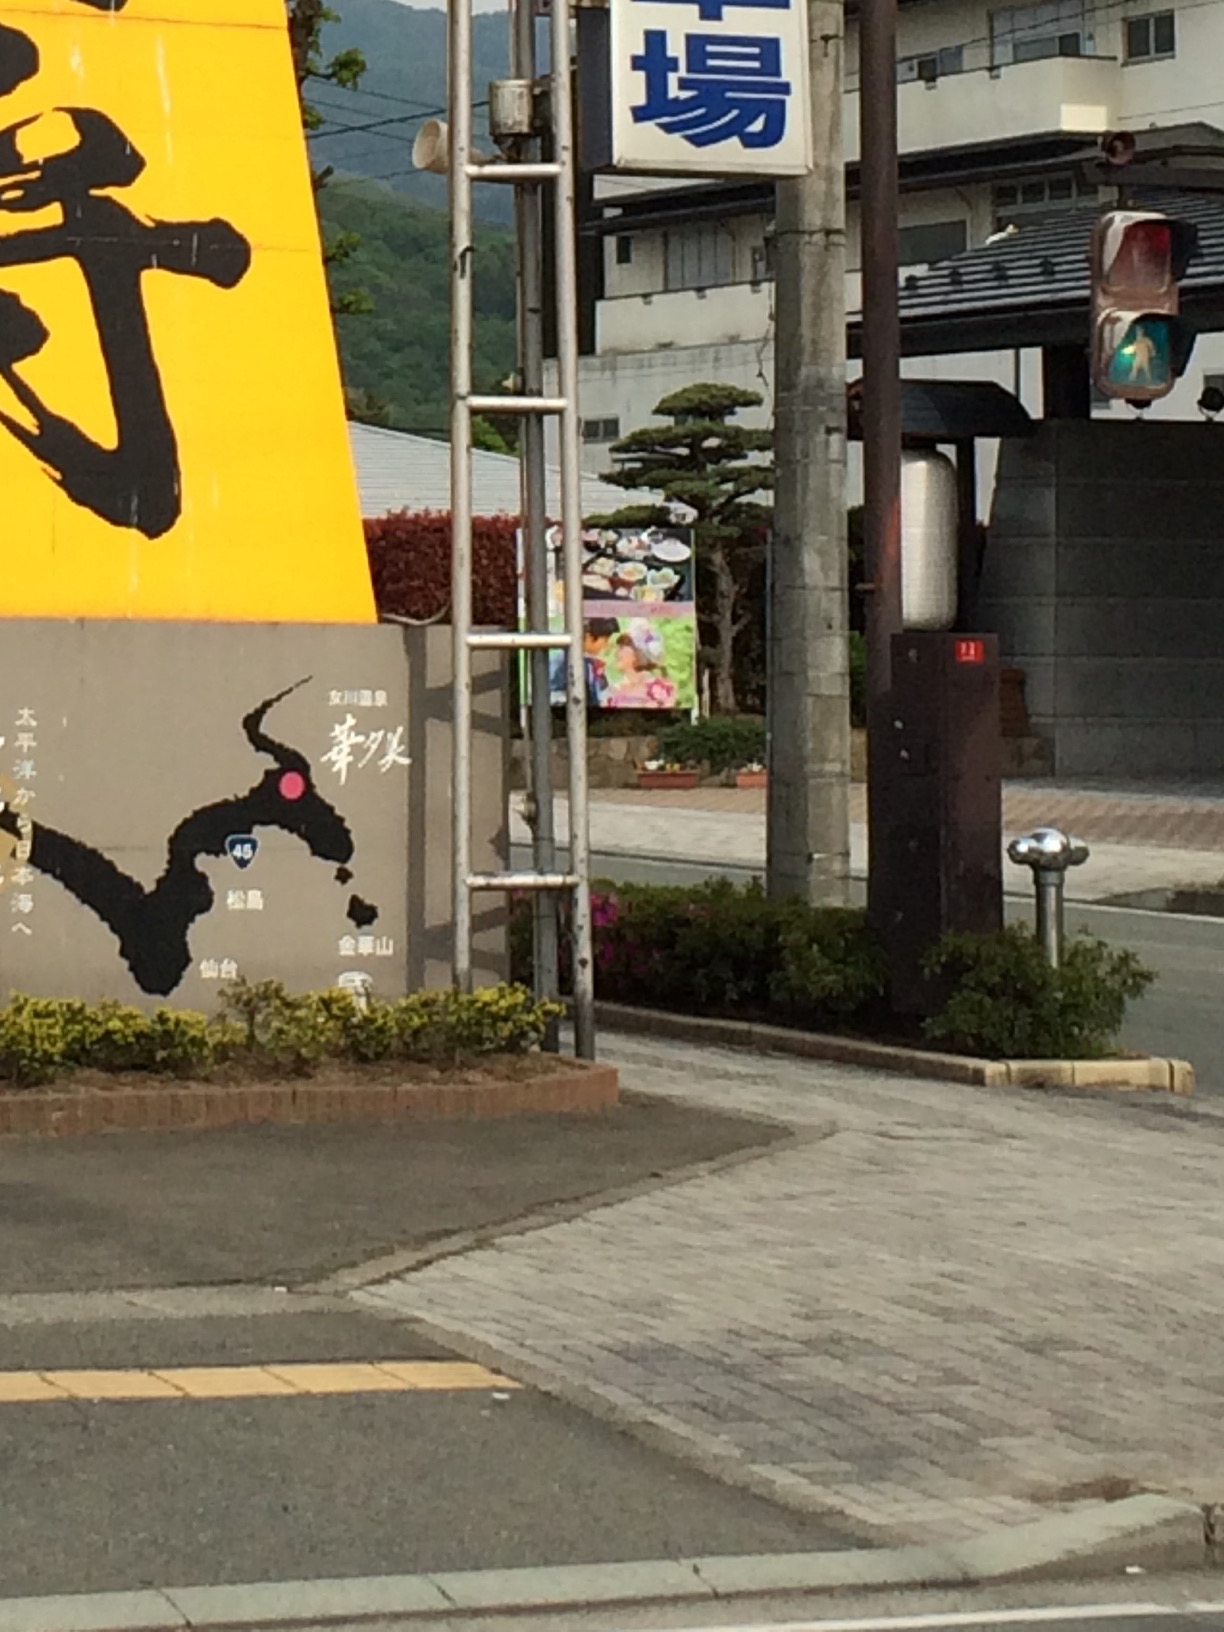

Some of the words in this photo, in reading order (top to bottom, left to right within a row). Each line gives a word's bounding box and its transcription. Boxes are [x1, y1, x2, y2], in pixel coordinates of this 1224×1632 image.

[11, 707, 37, 935] 太平洋から日本海へ
[232, 844, 253, 859] 45
[226, 890, 263, 910] 松島
[339, 935, 394, 956] 金華山
[200, 958, 238, 979] 仙台
